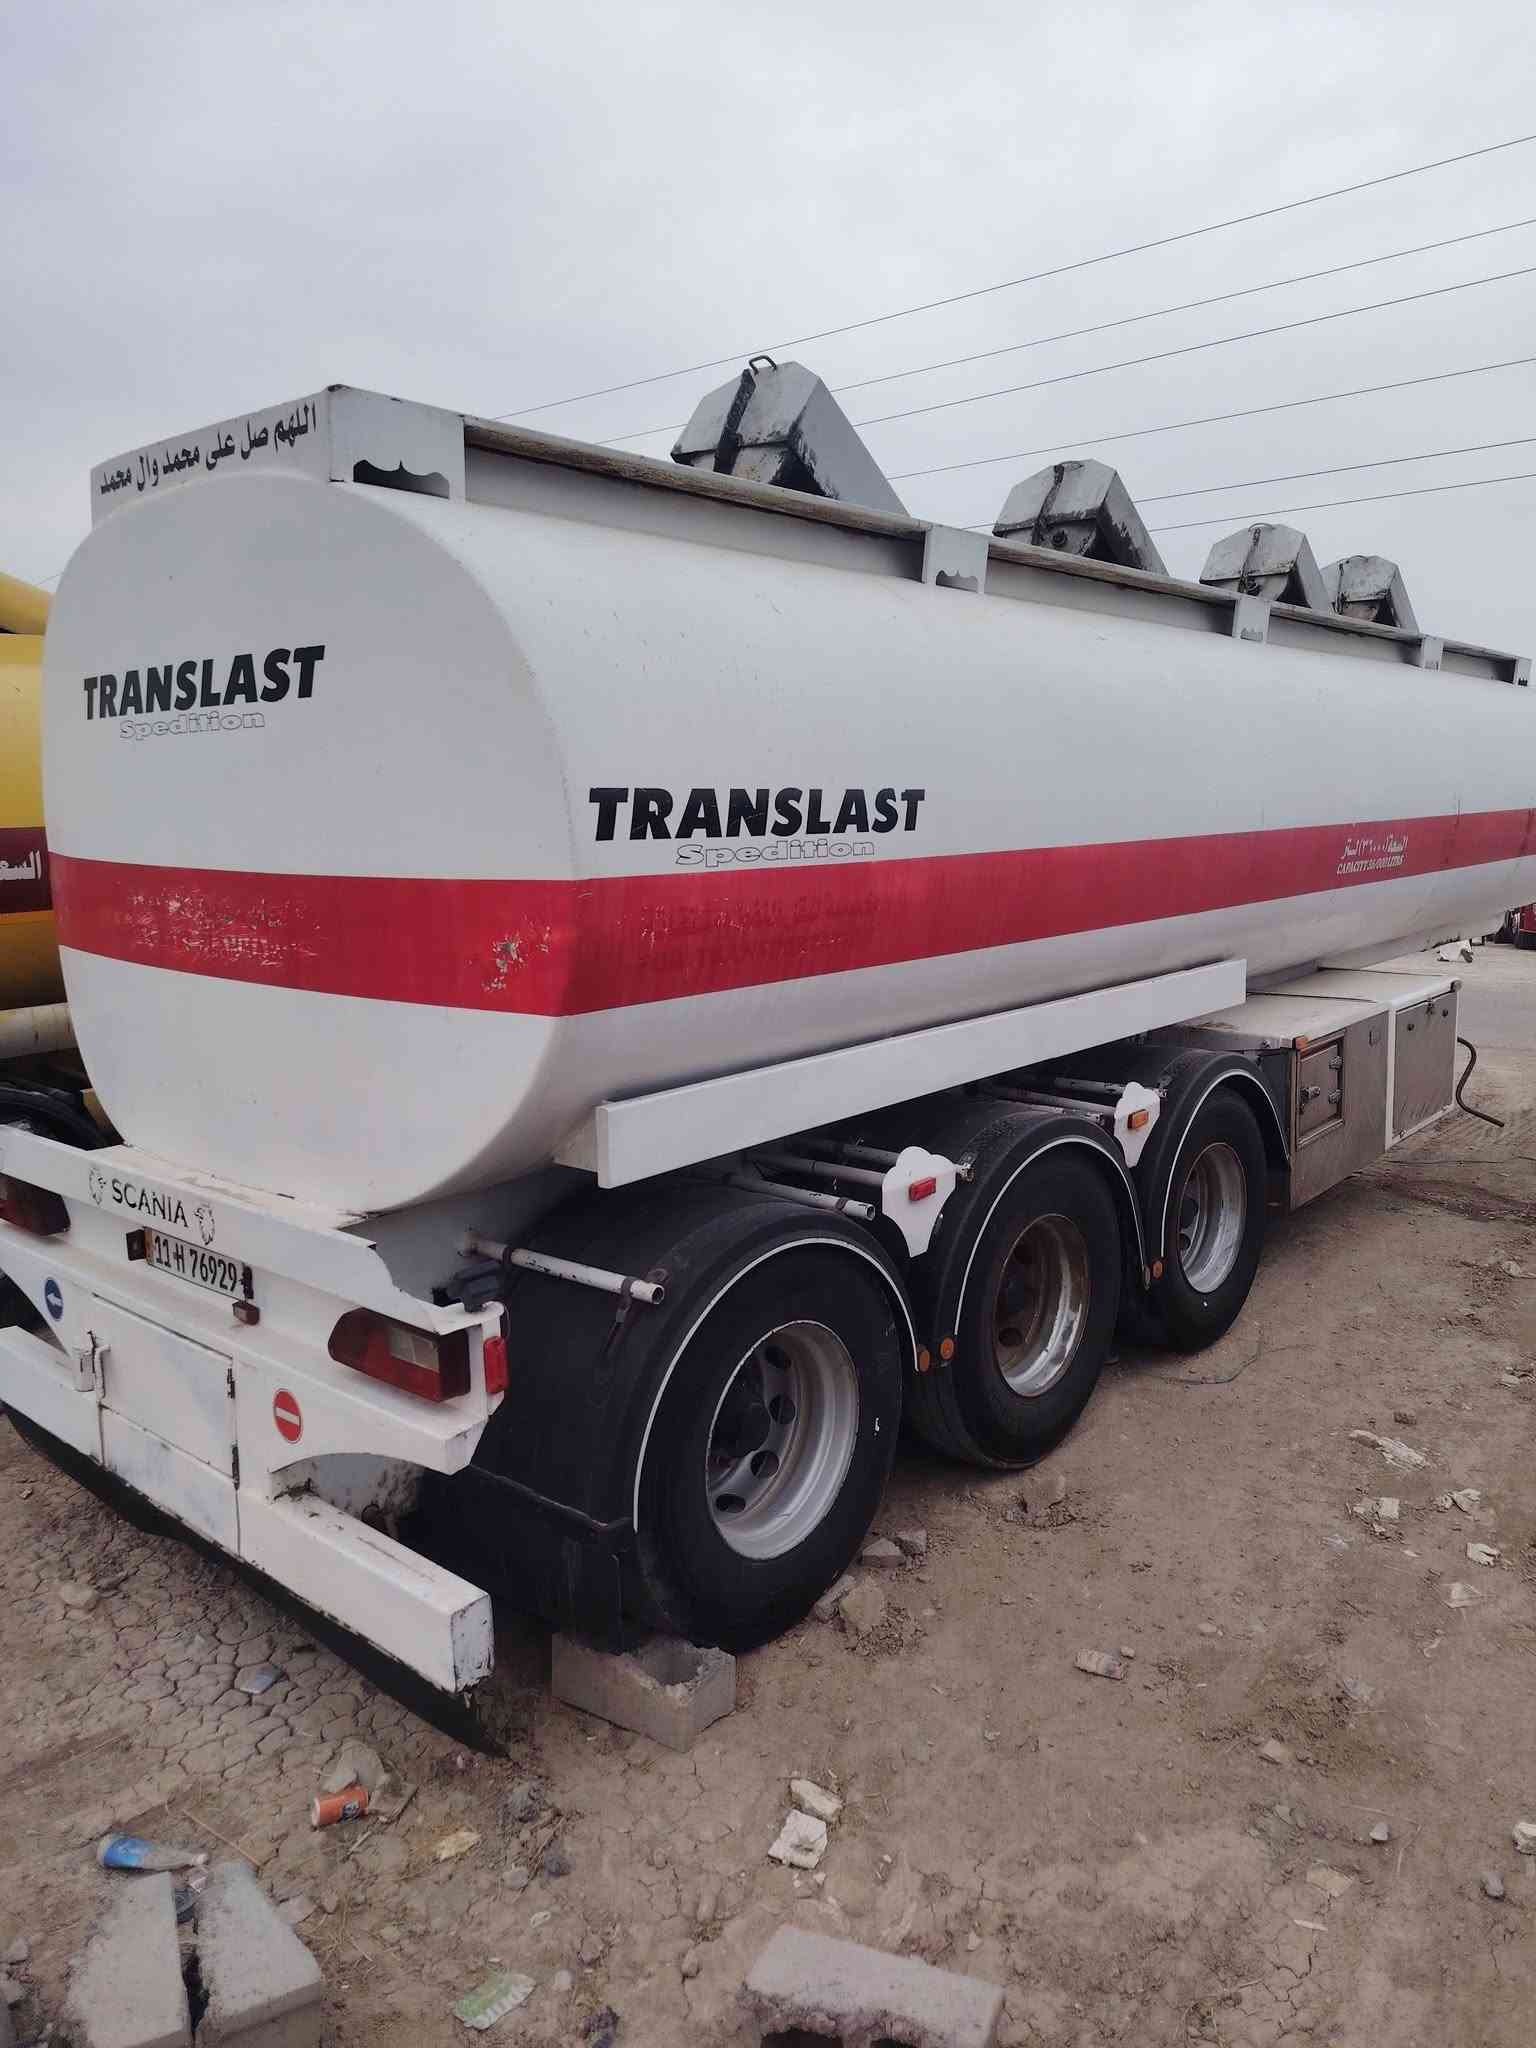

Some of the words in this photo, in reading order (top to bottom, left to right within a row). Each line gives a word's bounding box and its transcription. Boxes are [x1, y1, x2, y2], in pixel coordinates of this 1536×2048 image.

[241, 420, 269, 460] صل
[274, 400, 317, 454] اللهم
[101, 467, 132, 494] محمد
[163, 445, 200, 475] محمد
[84, 645, 325, 720] TRANSLAST
[119, 710, 265, 741] Spedition
[589, 787, 925, 841] TRANSLAST
[675, 838, 875, 868] Spedition
[112, 1178, 188, 1228] SCANIA
[155, 1235, 171, 1268] 11
[190, 1248, 237, 1292] 76929
